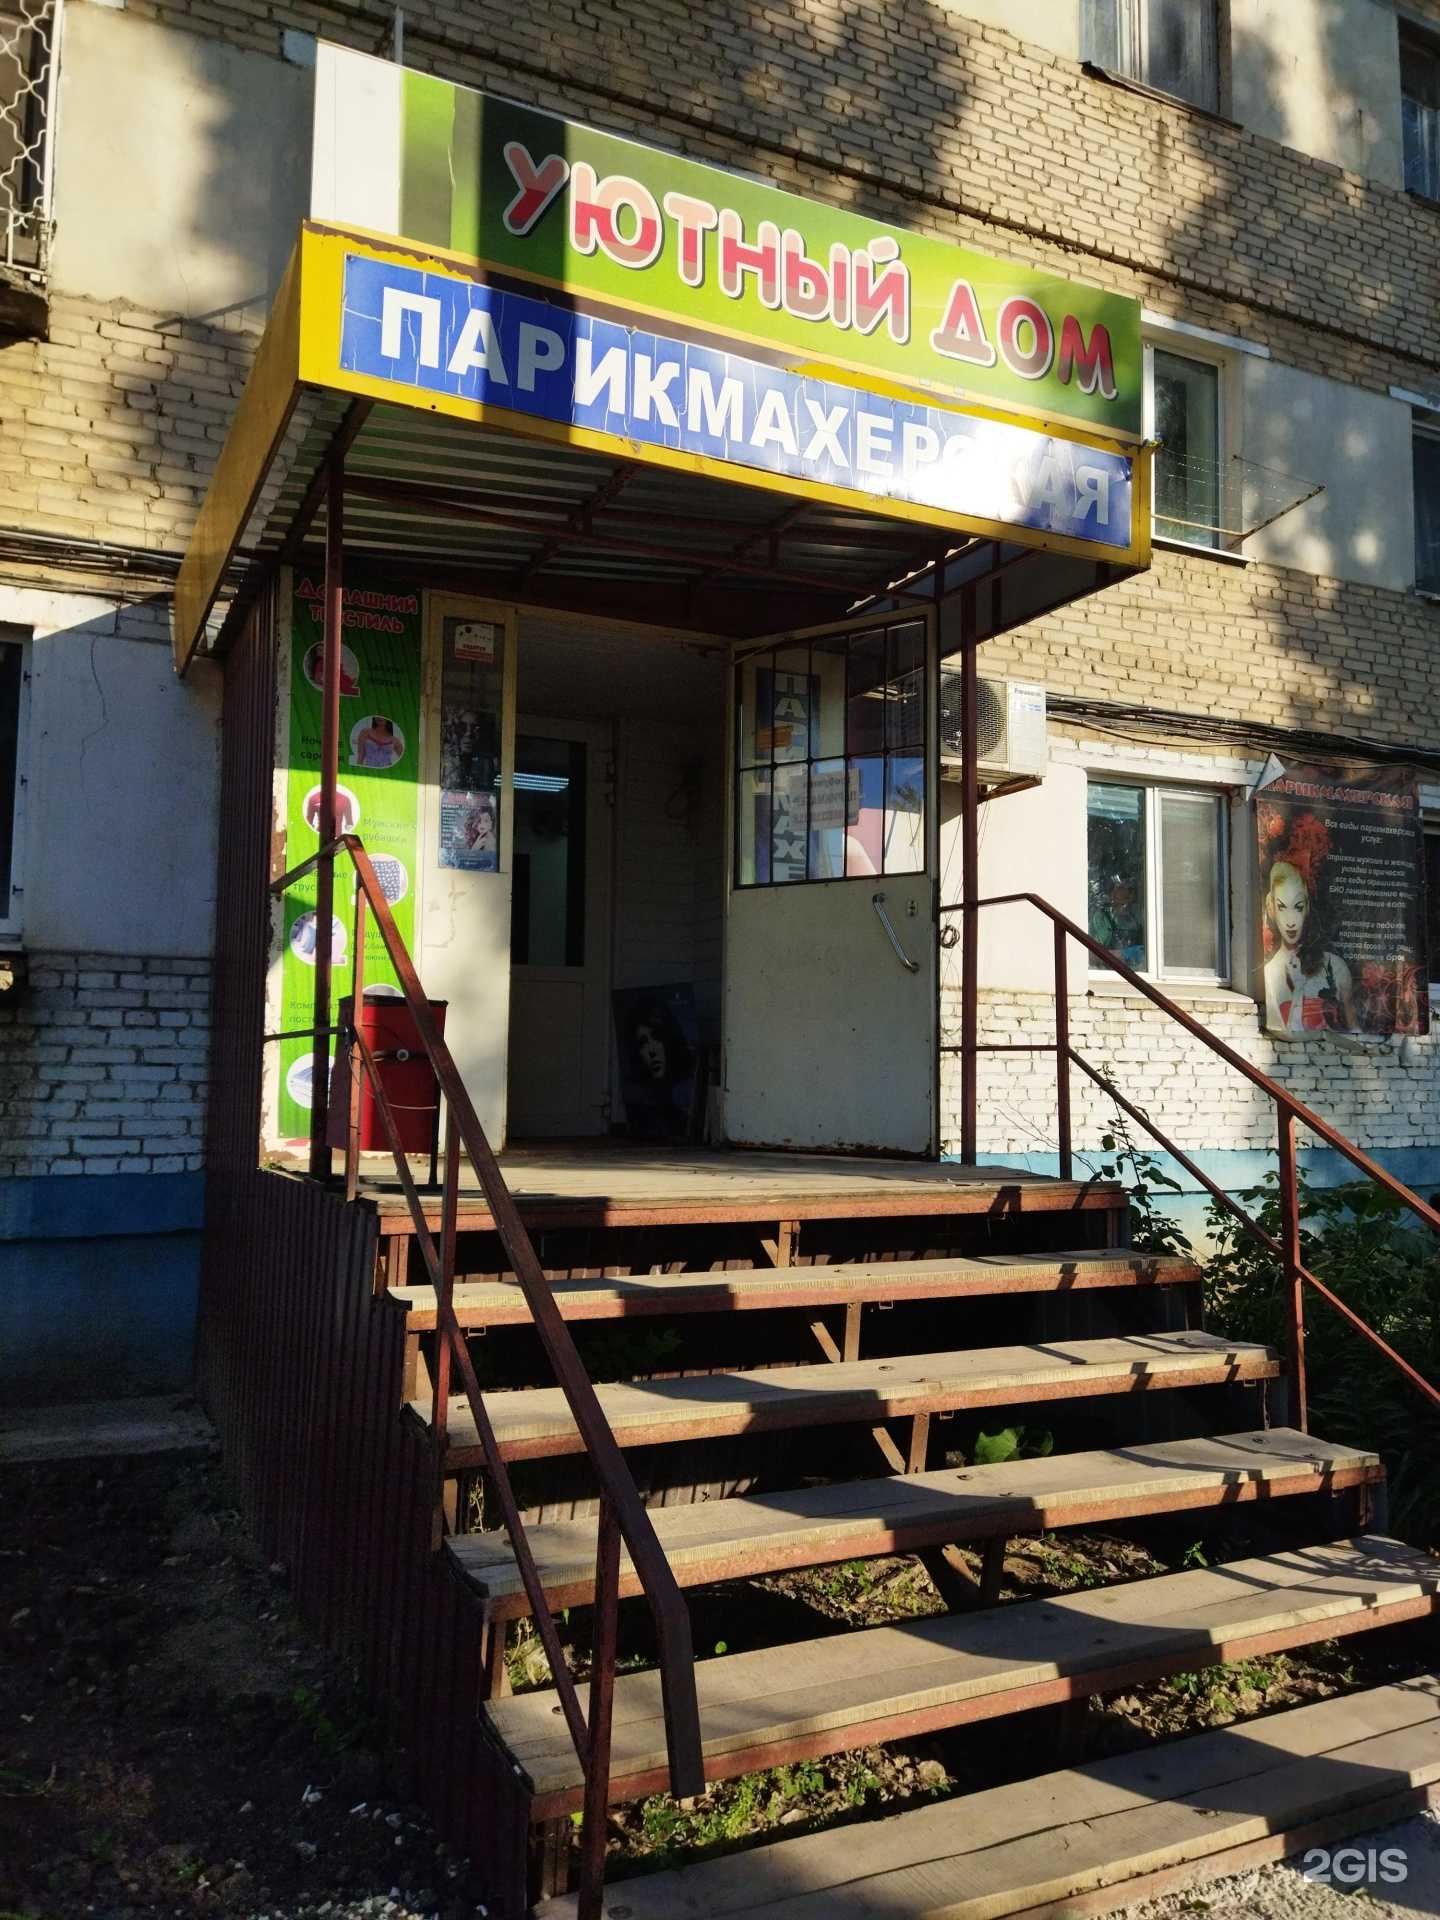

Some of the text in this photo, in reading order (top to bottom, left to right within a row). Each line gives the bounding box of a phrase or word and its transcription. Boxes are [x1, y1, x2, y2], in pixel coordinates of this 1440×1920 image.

[503, 141, 1118, 400] УЮТНЫЙ ДОМ
[380, 286, 1109, 525] ПАРИКМАХЕРАЯ
